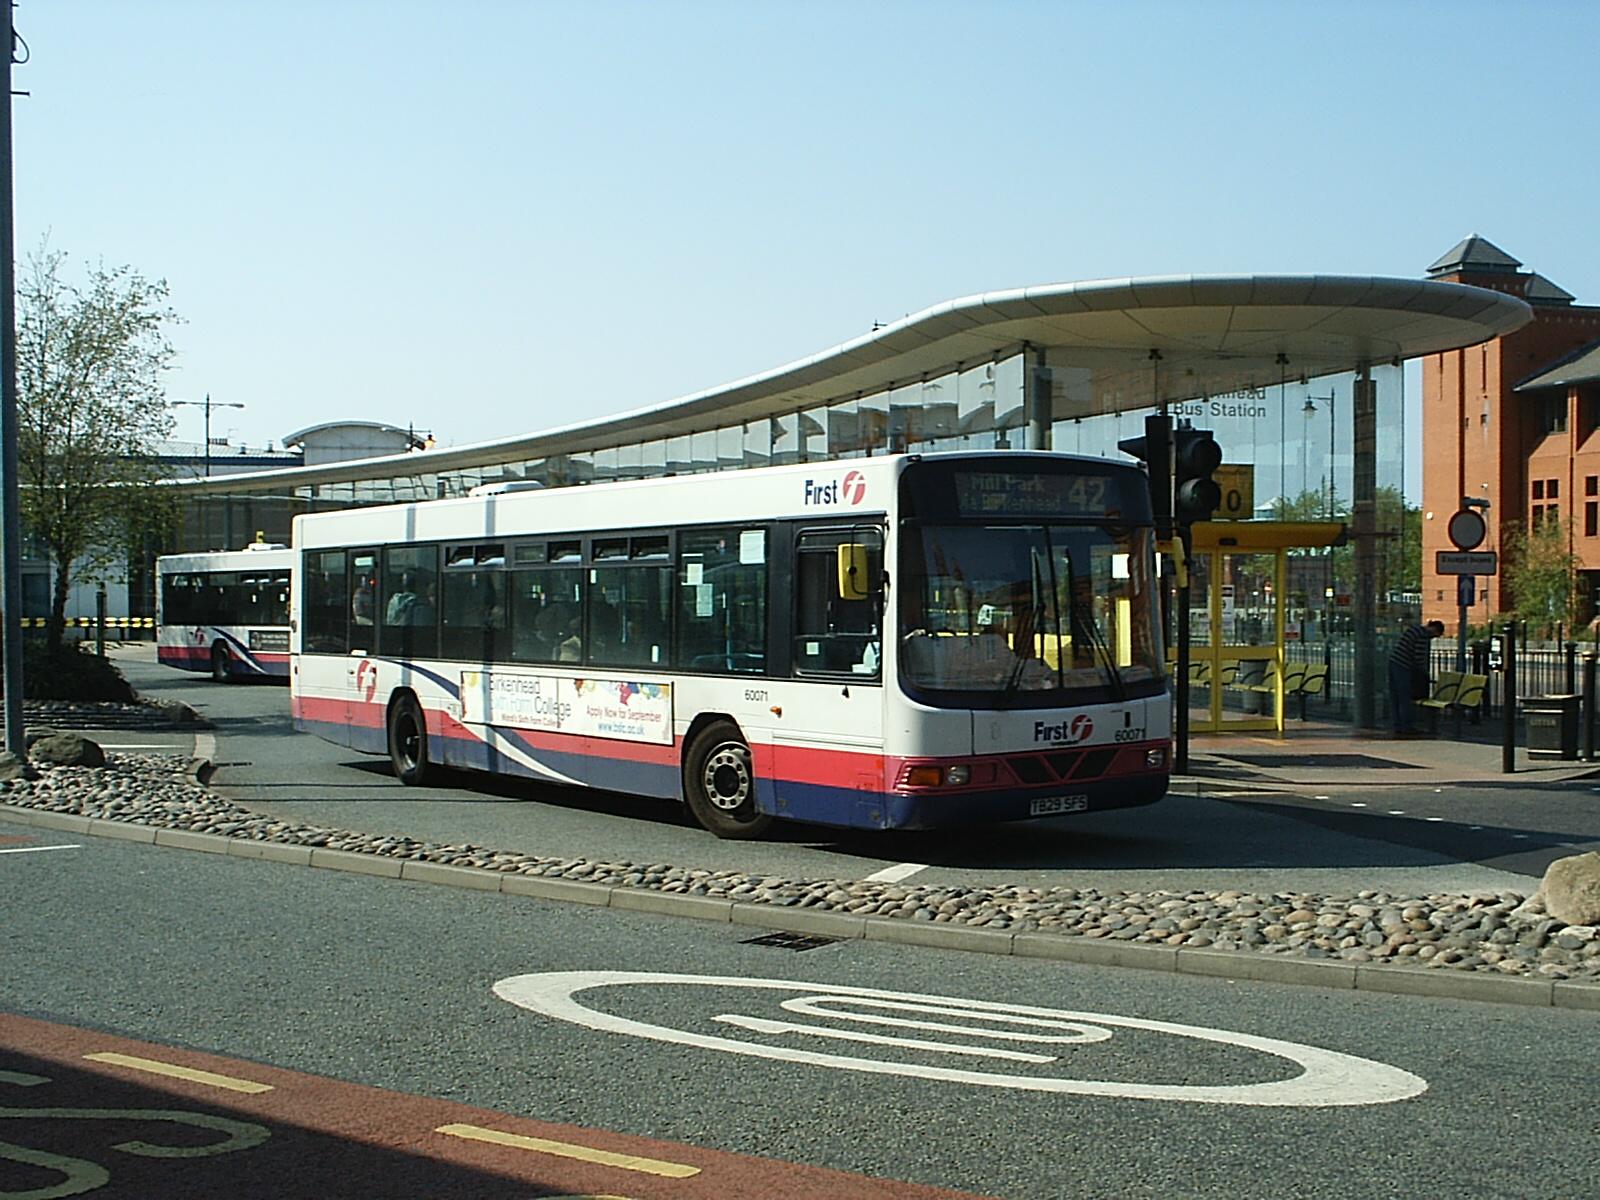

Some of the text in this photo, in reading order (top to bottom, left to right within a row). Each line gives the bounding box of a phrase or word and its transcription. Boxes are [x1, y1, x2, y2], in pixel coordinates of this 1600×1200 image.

[1173, 402, 1266, 417] Bus Station
[804, 479, 838, 505] First
[1068, 478, 1105, 512] 42
[744, 688, 769, 702] 60071
[534, 696, 572, 721] College
[1034, 720, 1069, 742] First
[1114, 728, 1146, 742] 60071
